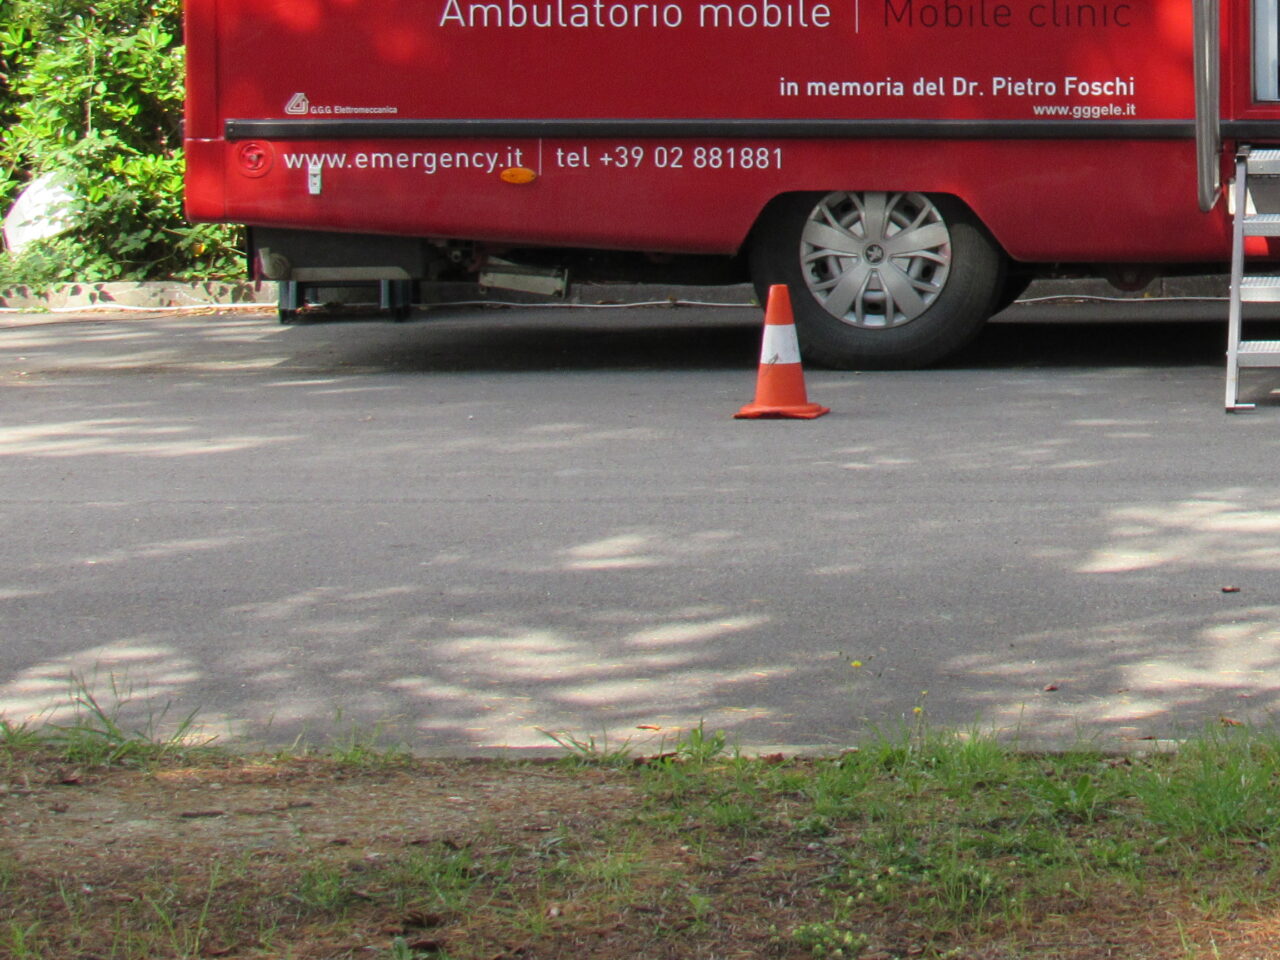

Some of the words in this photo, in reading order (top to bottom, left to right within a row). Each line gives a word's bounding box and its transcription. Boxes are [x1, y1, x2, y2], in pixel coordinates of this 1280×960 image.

[780, 76, 799, 96] in
[807, 76, 905, 97] memoria
[912, 76, 946, 96] del
[952, 76, 984, 96] Dr.
[992, 76, 1057, 96] Pietro
[1064, 76, 1135, 96] Foschi
[334, 105, 398, 115] Elettromeccanica
[1032, 103, 1137, 119] www.gggele.it
[283, 146, 524, 175] www.emergency.it
[556, 146, 591, 168] tel
[599, 146, 644, 169] +39
[654, 147, 684, 169] 02
[693, 147, 783, 170] 881881
